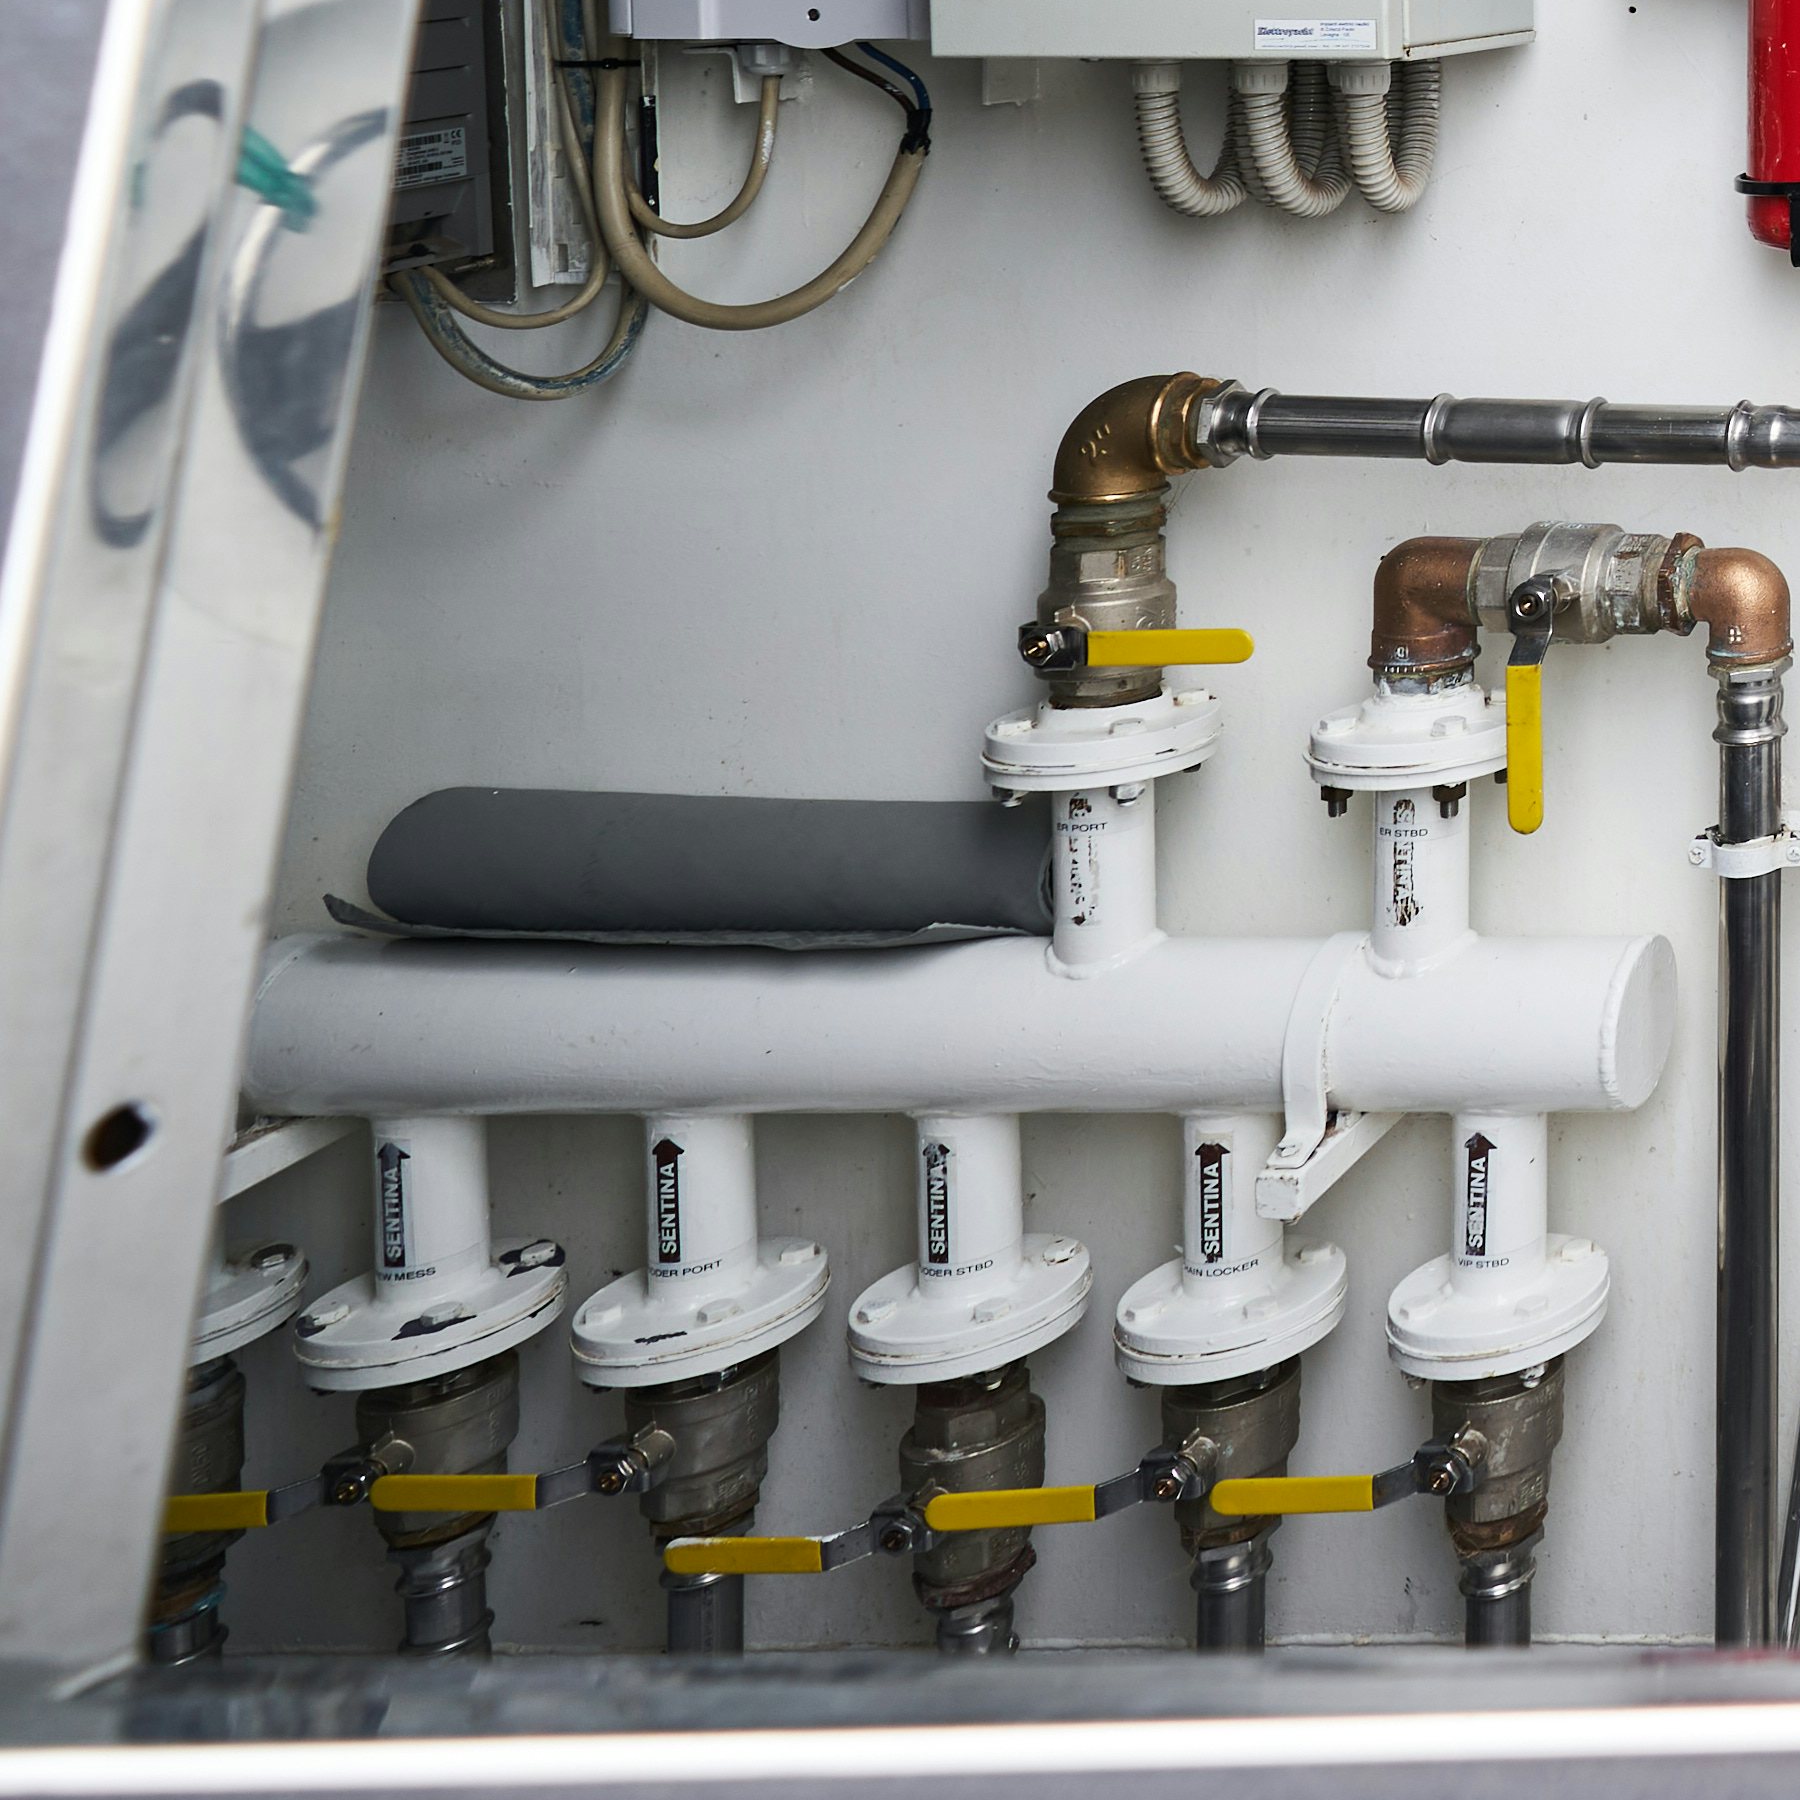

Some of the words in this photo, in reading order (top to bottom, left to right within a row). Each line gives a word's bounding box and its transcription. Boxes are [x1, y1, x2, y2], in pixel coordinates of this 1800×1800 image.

[1071, 821, 1108, 833] PORT
[1393, 828, 1429, 838] STBD
[383, 1166, 402, 1259] SENTINA
[661, 1162, 677, 1254] SENTINA
[929, 1164, 946, 1255] SENTINA
[1203, 1162, 1221, 1254] SENTINA
[681, 1258, 722, 1277] PORT
[955, 1259, 995, 1277] STBD
[1205, 1258, 1260, 1278] LOCKER
[1475, 1257, 1510, 1270] STBD
[394, 1266, 437, 1282] MESS
